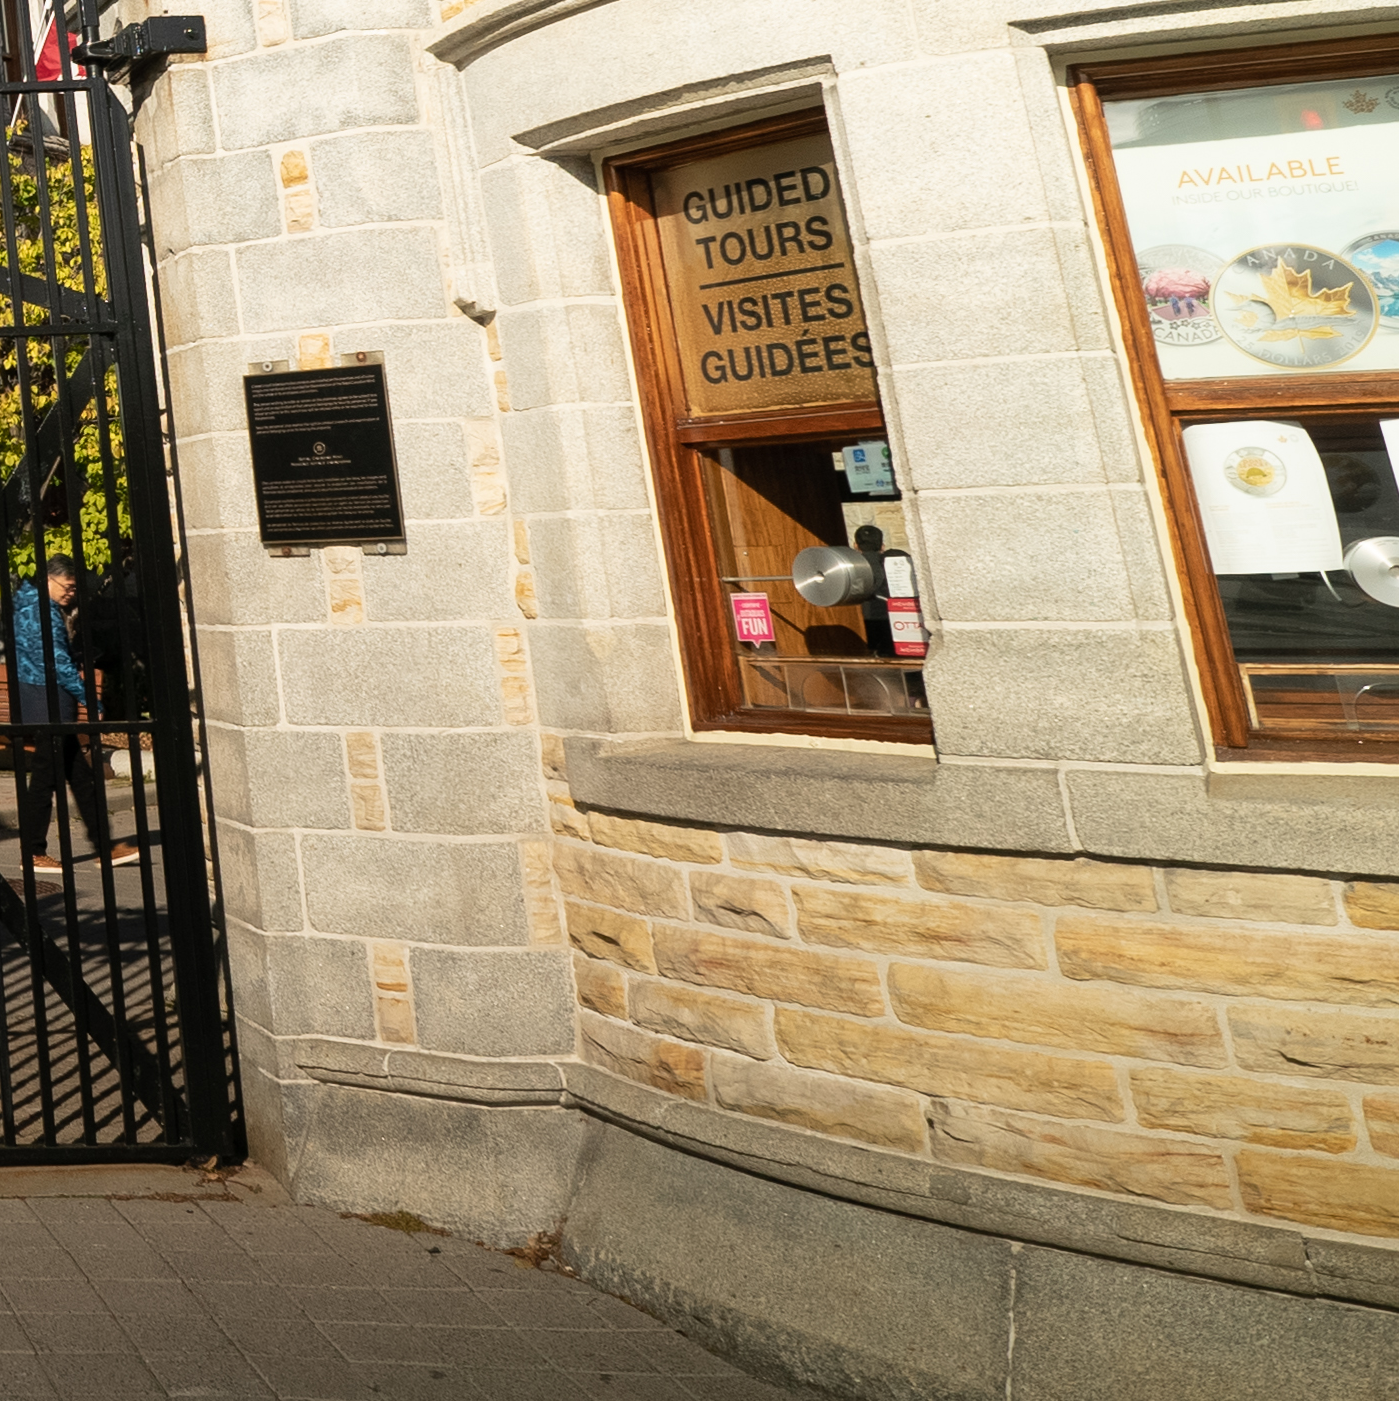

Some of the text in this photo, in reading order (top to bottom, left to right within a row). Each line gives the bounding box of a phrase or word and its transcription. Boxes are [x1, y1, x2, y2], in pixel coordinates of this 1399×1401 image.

[1177, 156, 1344, 189] AVAILABLE
[683, 166, 831, 224] GUIDED
[1172, 180, 1359, 206] INSIDE OUR BOUTIQUE!
[695, 215, 833, 269] TOURS
[1232, 248, 1335, 274] CANADA
[702, 283, 853, 335] VISITES
[701, 329, 875, 384] GUIDÉES
[1235, 329, 1365, 366] 25 DOLLARS 2019
[741, 618, 769, 636] FUN
